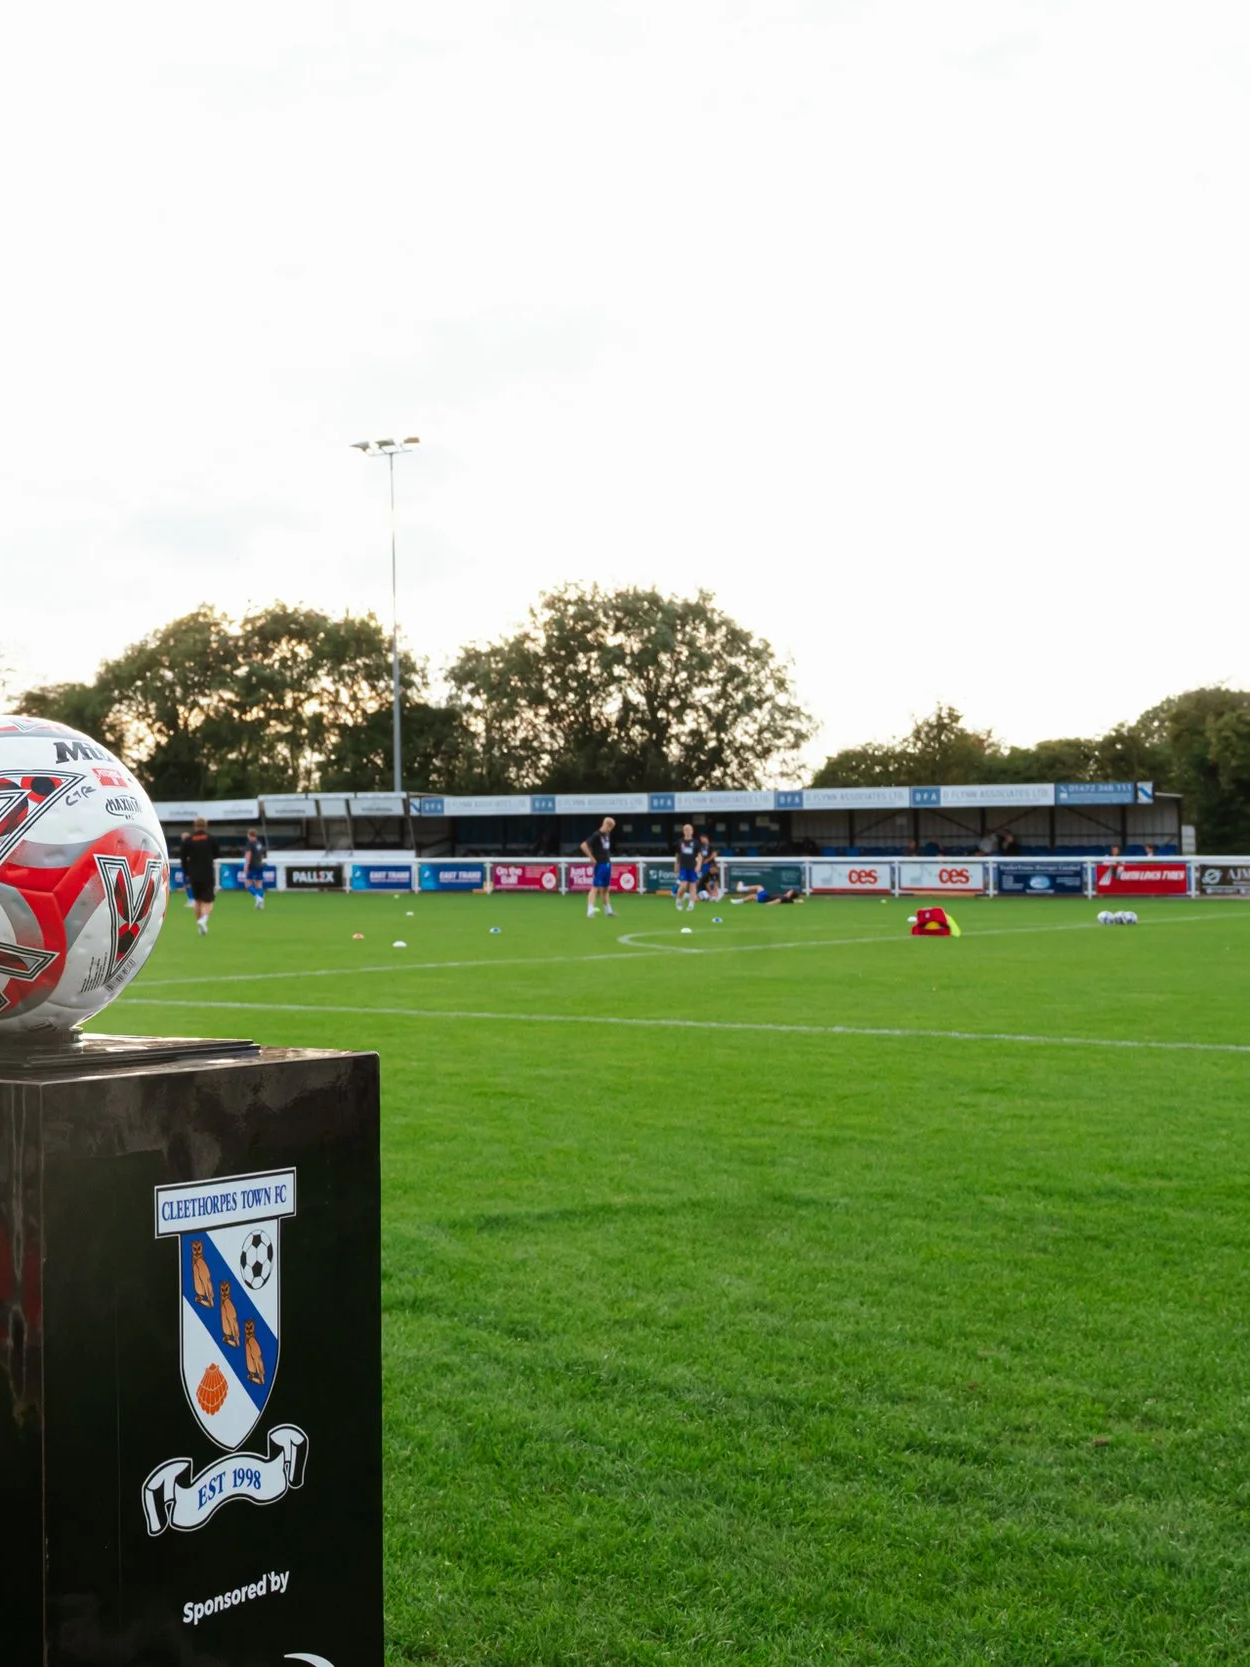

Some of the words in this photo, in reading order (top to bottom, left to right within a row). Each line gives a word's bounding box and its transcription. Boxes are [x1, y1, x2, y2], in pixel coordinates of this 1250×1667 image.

[509, 866, 523, 876] the
[848, 868, 878, 884] ces
[939, 868, 970, 884] ces
[162, 1191, 237, 1221] CLEETHORPES
[241, 1187, 271, 1209] TOWN
[274, 1184, 286, 1204] FC
[198, 1471, 226, 1510] EST
[232, 1467, 262, 1490] 1998
[183, 1574, 267, 1625] Sponsored
[269, 1570, 290, 1593] by
